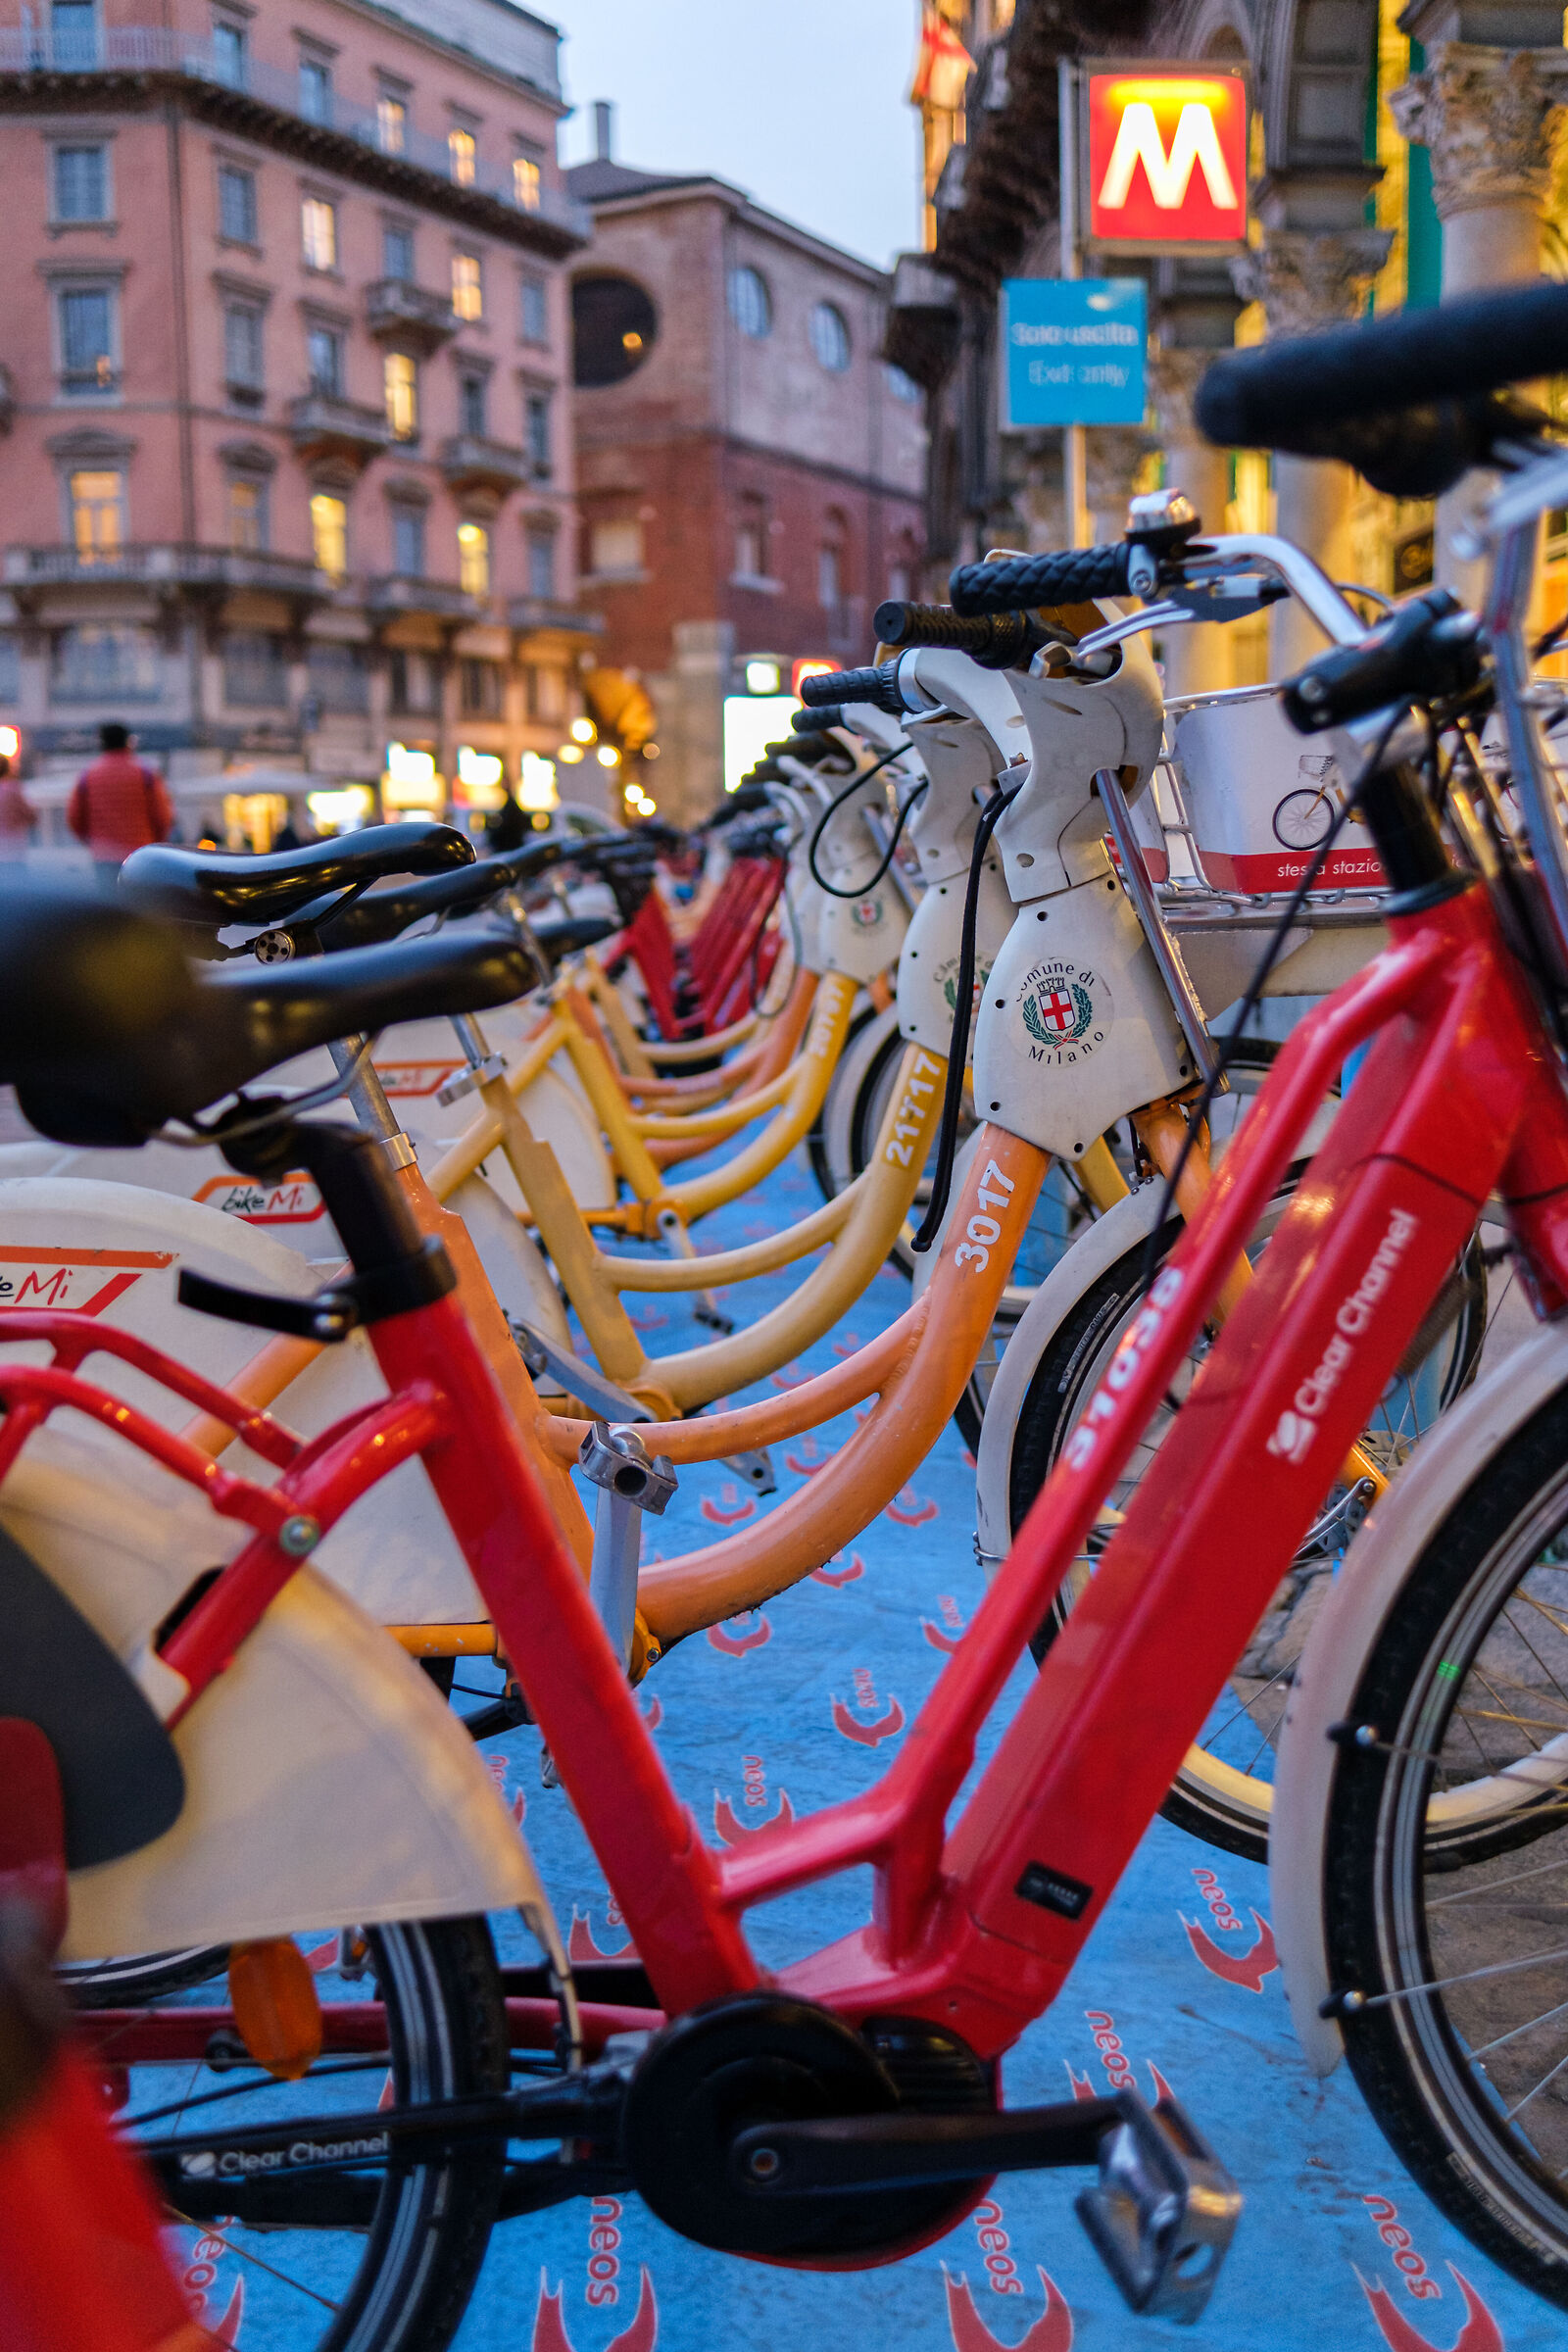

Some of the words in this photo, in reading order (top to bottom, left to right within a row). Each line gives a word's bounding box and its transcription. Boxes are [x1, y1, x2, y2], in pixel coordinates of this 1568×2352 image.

[1098, 102, 1239, 209] M
[1277, 862, 1326, 877] stesa
[1029, 1031, 1104, 1064] Milano
[886, 1052, 941, 1168] 21717
[955, 1159, 1015, 1273] 3017
[1294, 1332, 1354, 1416] Clear
[1336, 1207, 1418, 1336] Channel
[742, 1754, 768, 1807] neos
[1191, 1868, 1243, 1932] neos
[1081, 2010, 1136, 2090] neos
[220, 2150, 285, 2173] Clear
[290, 2131, 389, 2164] Channel
[585, 2195, 622, 2307] neos
[972, 2198, 1025, 2295] neos
[1361, 2194, 1443, 2300] neos
